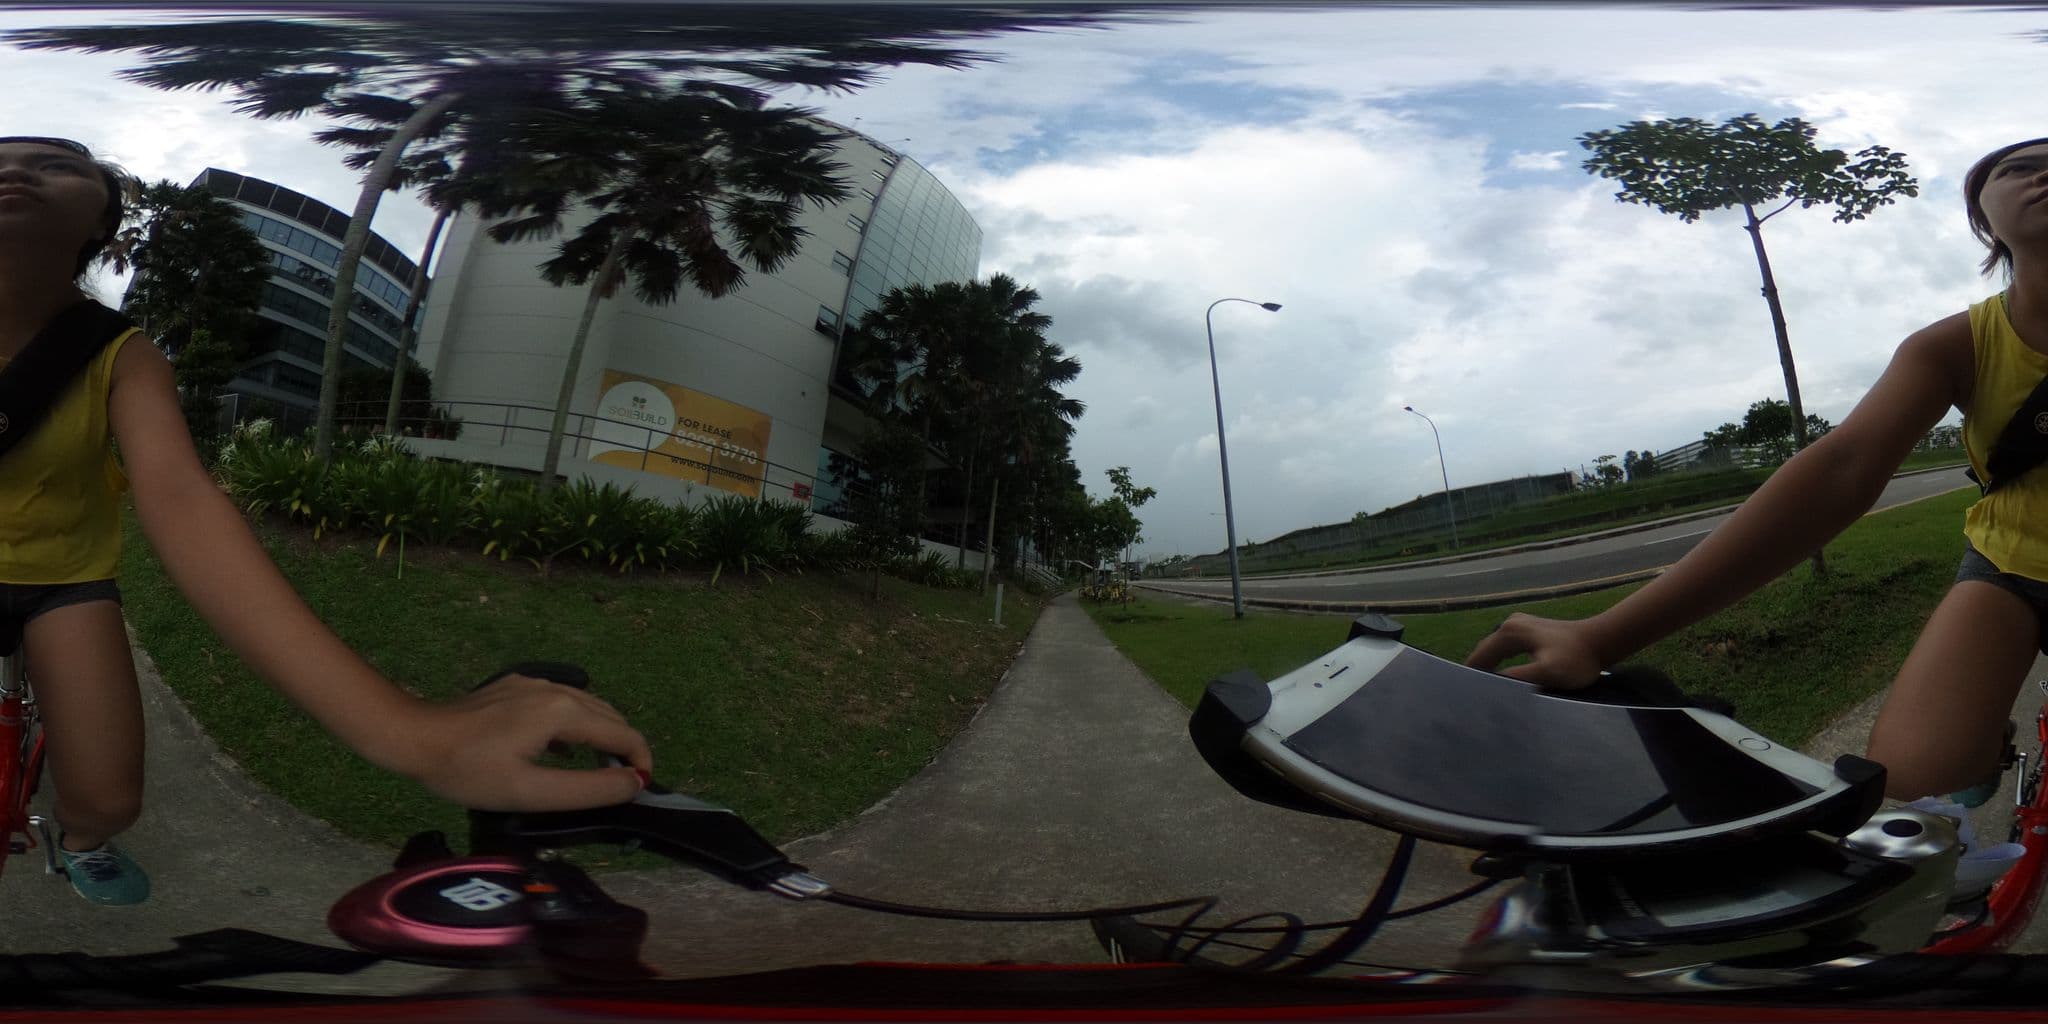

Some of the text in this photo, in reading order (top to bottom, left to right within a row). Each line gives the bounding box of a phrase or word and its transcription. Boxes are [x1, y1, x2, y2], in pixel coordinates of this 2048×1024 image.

[678, 416, 733, 440] FOR LEASE
[720, 441, 758, 465] 3770
